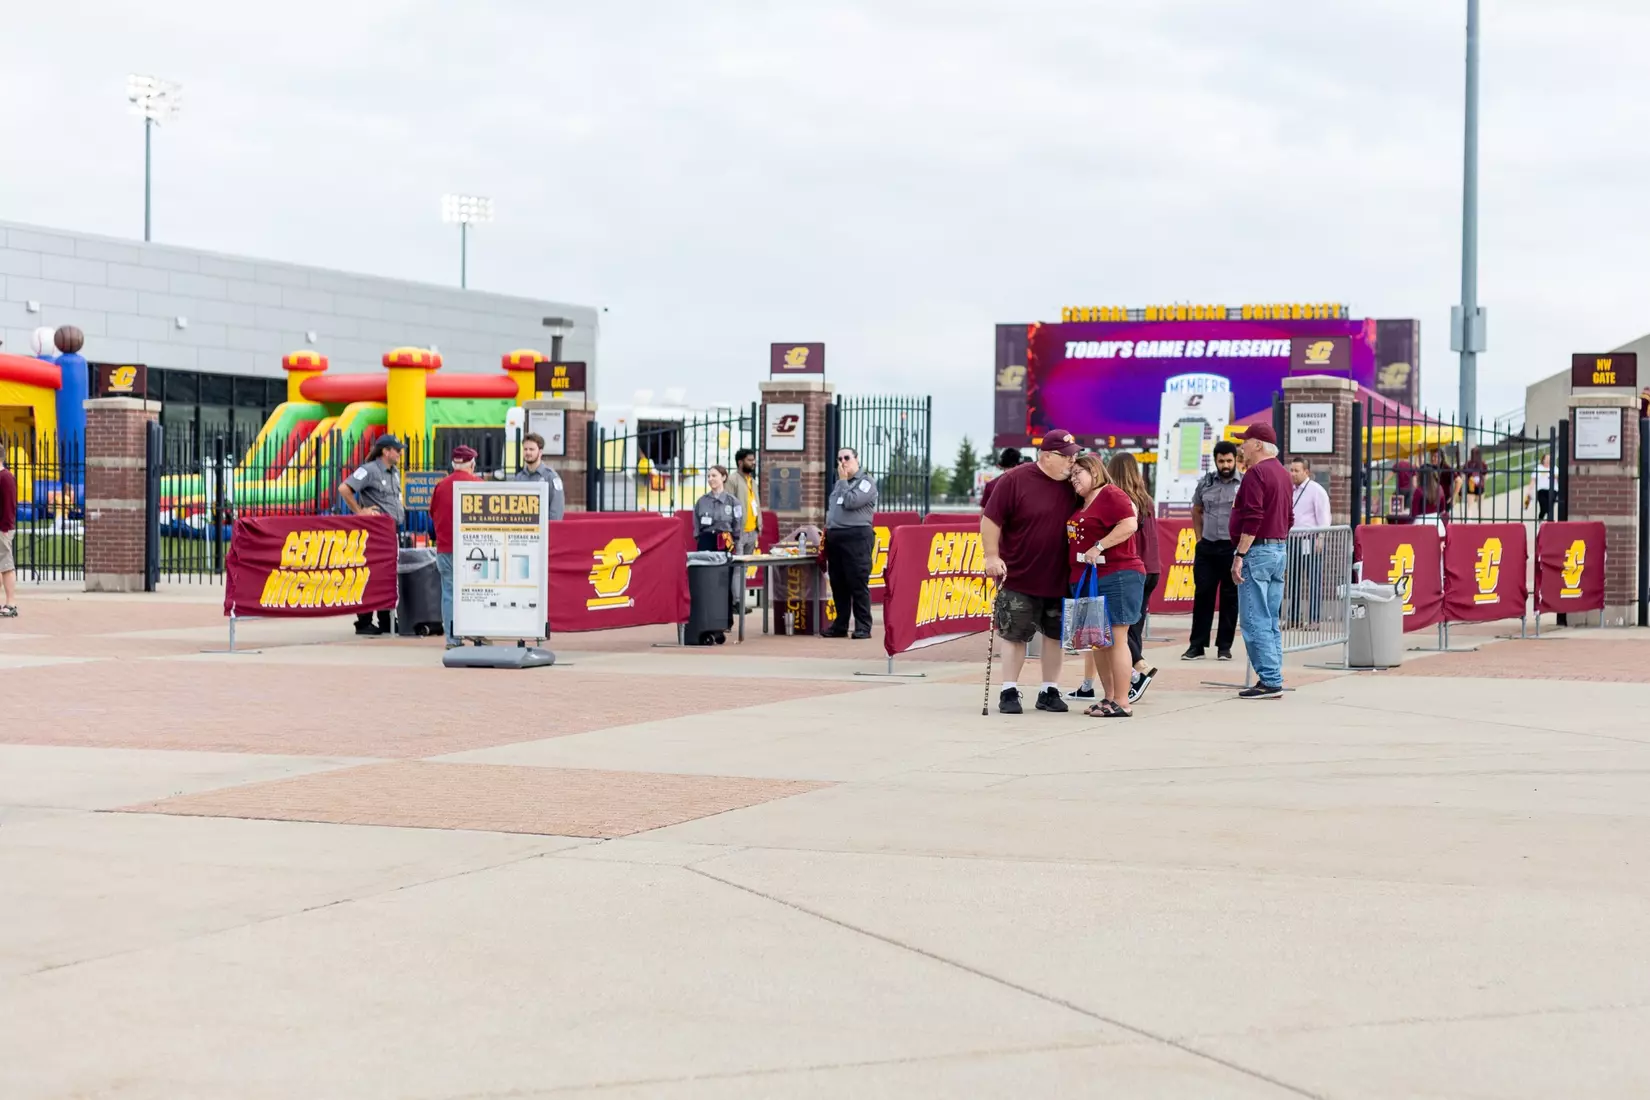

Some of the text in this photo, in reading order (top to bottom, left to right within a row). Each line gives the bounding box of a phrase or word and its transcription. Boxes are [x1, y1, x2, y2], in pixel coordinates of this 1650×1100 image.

[1062, 303, 1341, 322] CENTRAL MICHIGAN UNIVERSITY
[1065, 339, 1291, 358] TODAY'S GAME IS PRESENTE
[554, 366, 567, 377] NW
[1596, 358, 1612, 371] NW
[551, 377, 570, 389] GATE
[1592, 371, 1616, 384] GATE
[462, 495, 539, 514] BE CLEAR
[279, 529, 369, 570] CENTRAL
[259, 567, 370, 608] MICHIGAN
